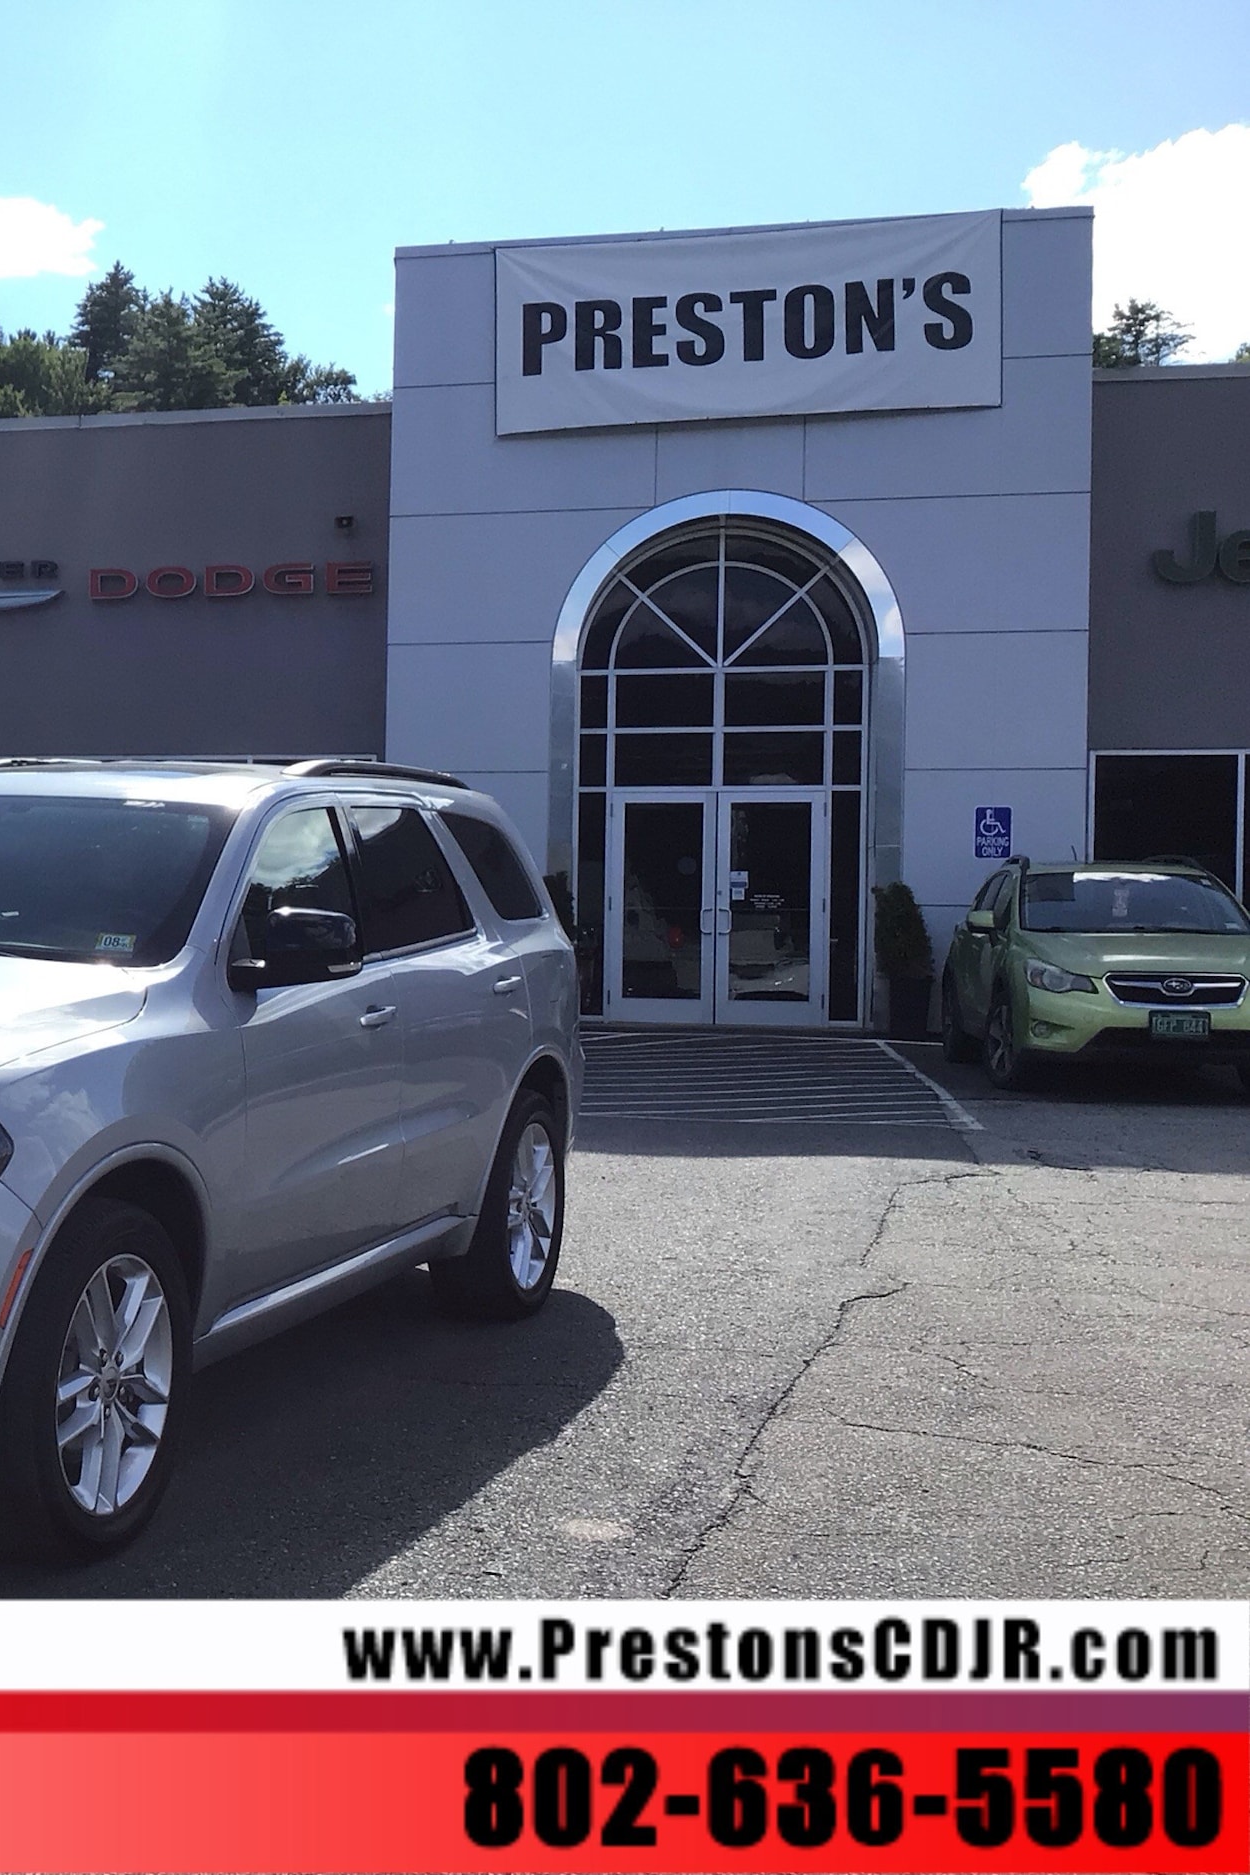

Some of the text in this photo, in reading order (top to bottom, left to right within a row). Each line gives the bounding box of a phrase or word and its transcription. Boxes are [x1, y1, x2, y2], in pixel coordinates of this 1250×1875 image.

[522, 271, 974, 377] PRESTON'S
[89, 561, 373, 598] DODGE
[976, 837, 1010, 847] PARKING
[981, 846, 1003, 857] ONLY
[103, 936, 121, 947] 08
